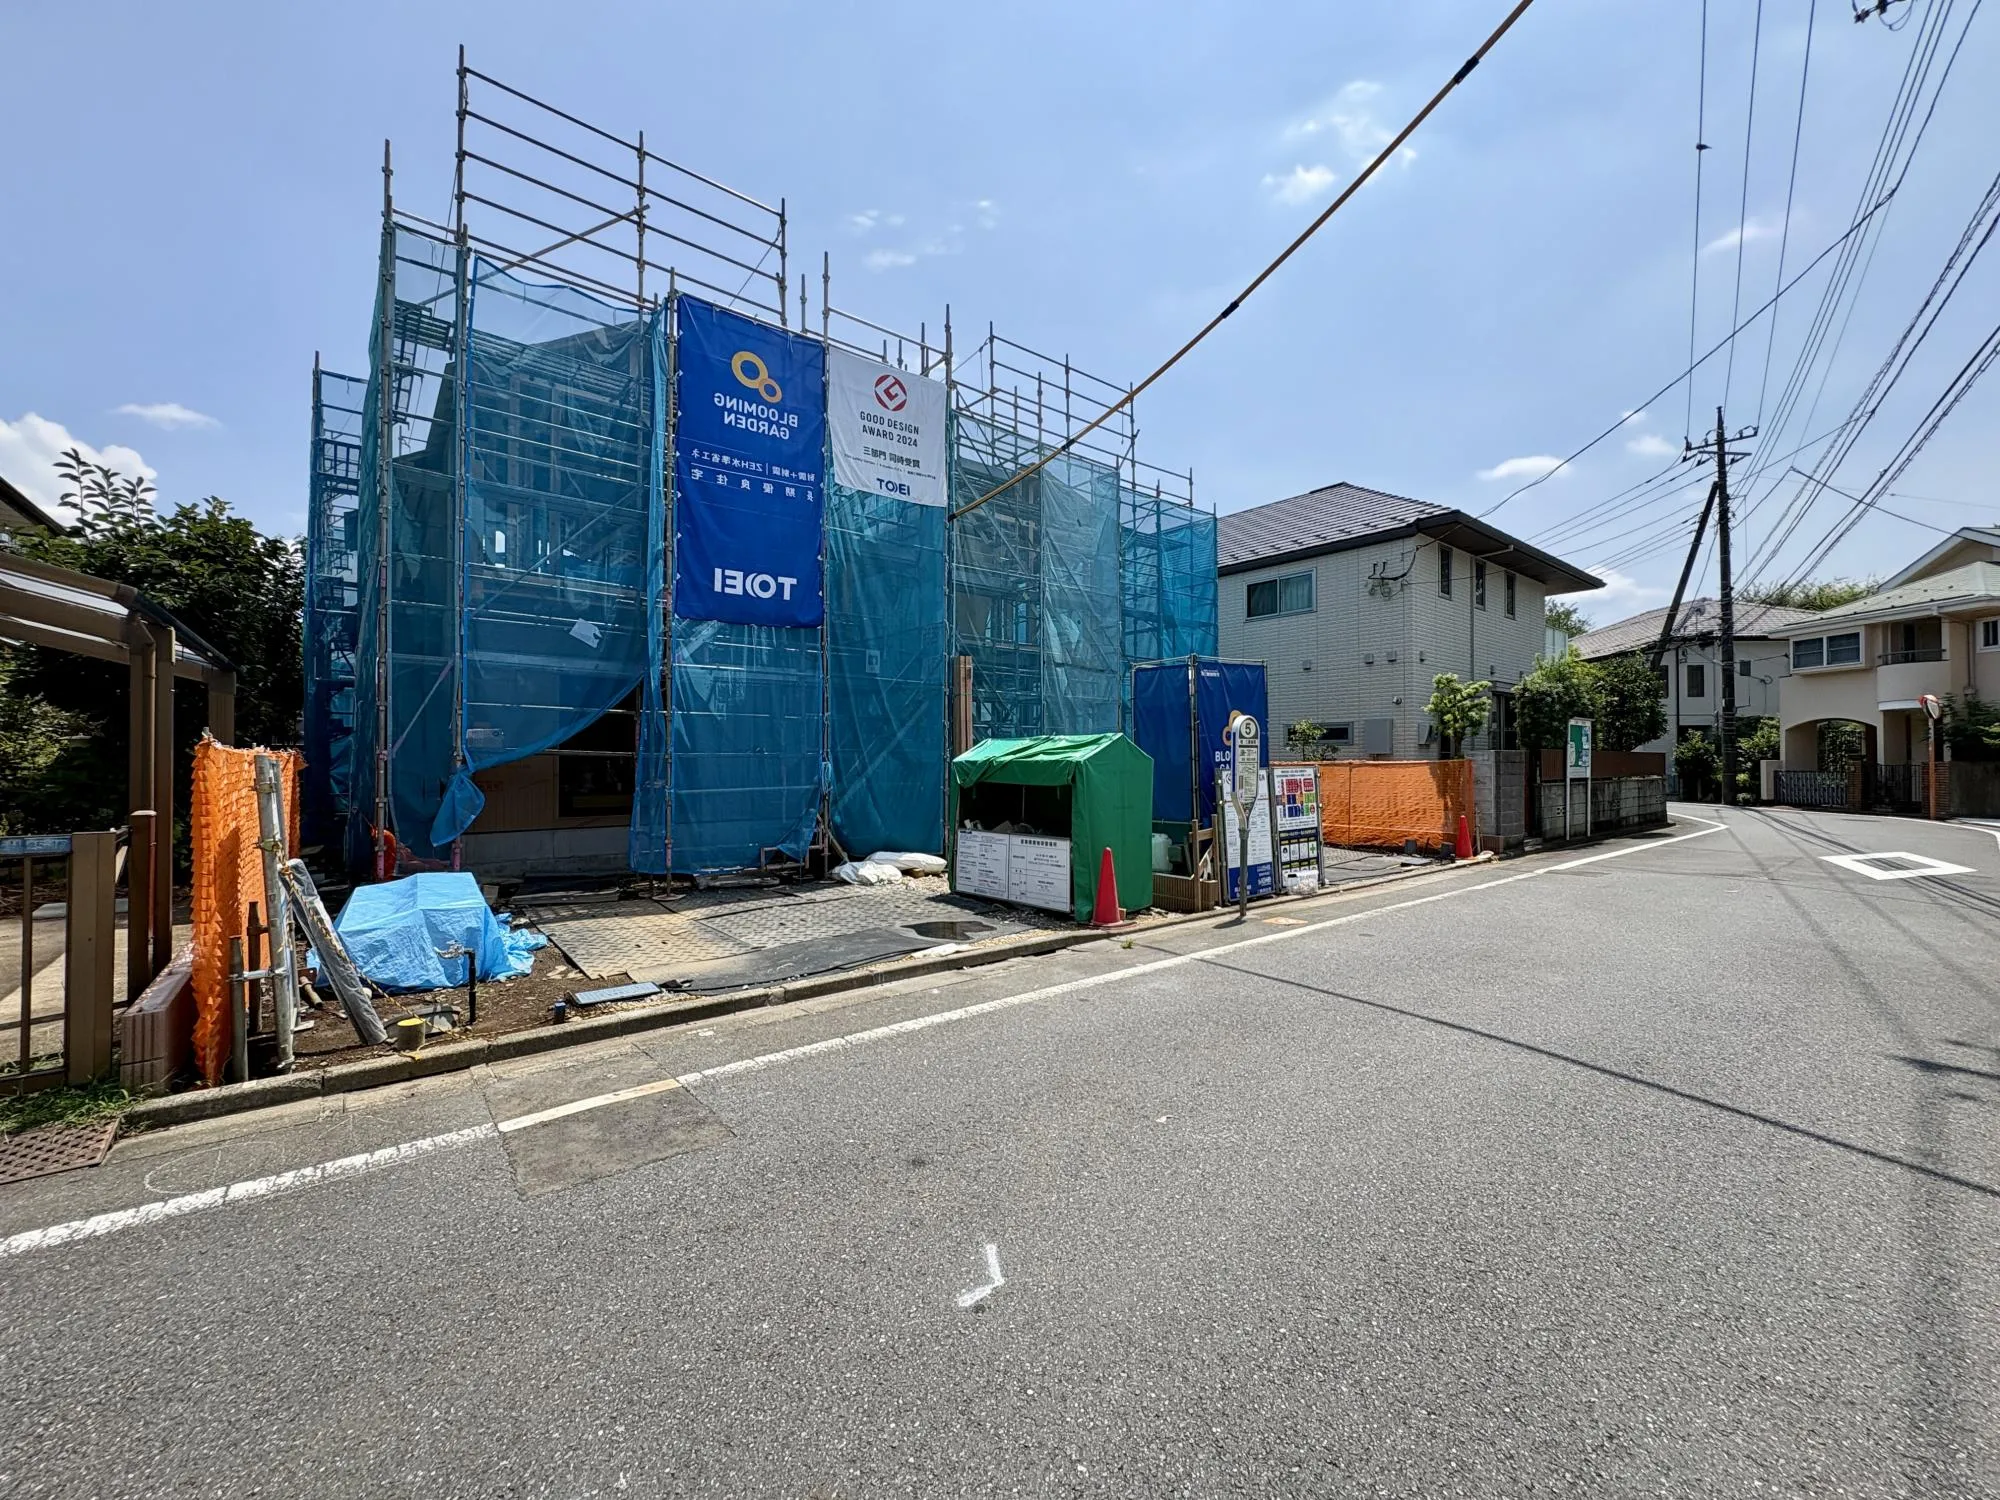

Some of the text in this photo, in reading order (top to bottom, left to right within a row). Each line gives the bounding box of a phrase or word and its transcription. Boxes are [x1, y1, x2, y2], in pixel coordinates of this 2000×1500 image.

[860, 411, 920, 435] GOOD DESIGN
[862, 424, 918, 448] AWARD 2024
[863, 446, 887, 461] 三部門
[1245, 723, 1251, 735] 5
[1215, 751, 1231, 762] BLO
